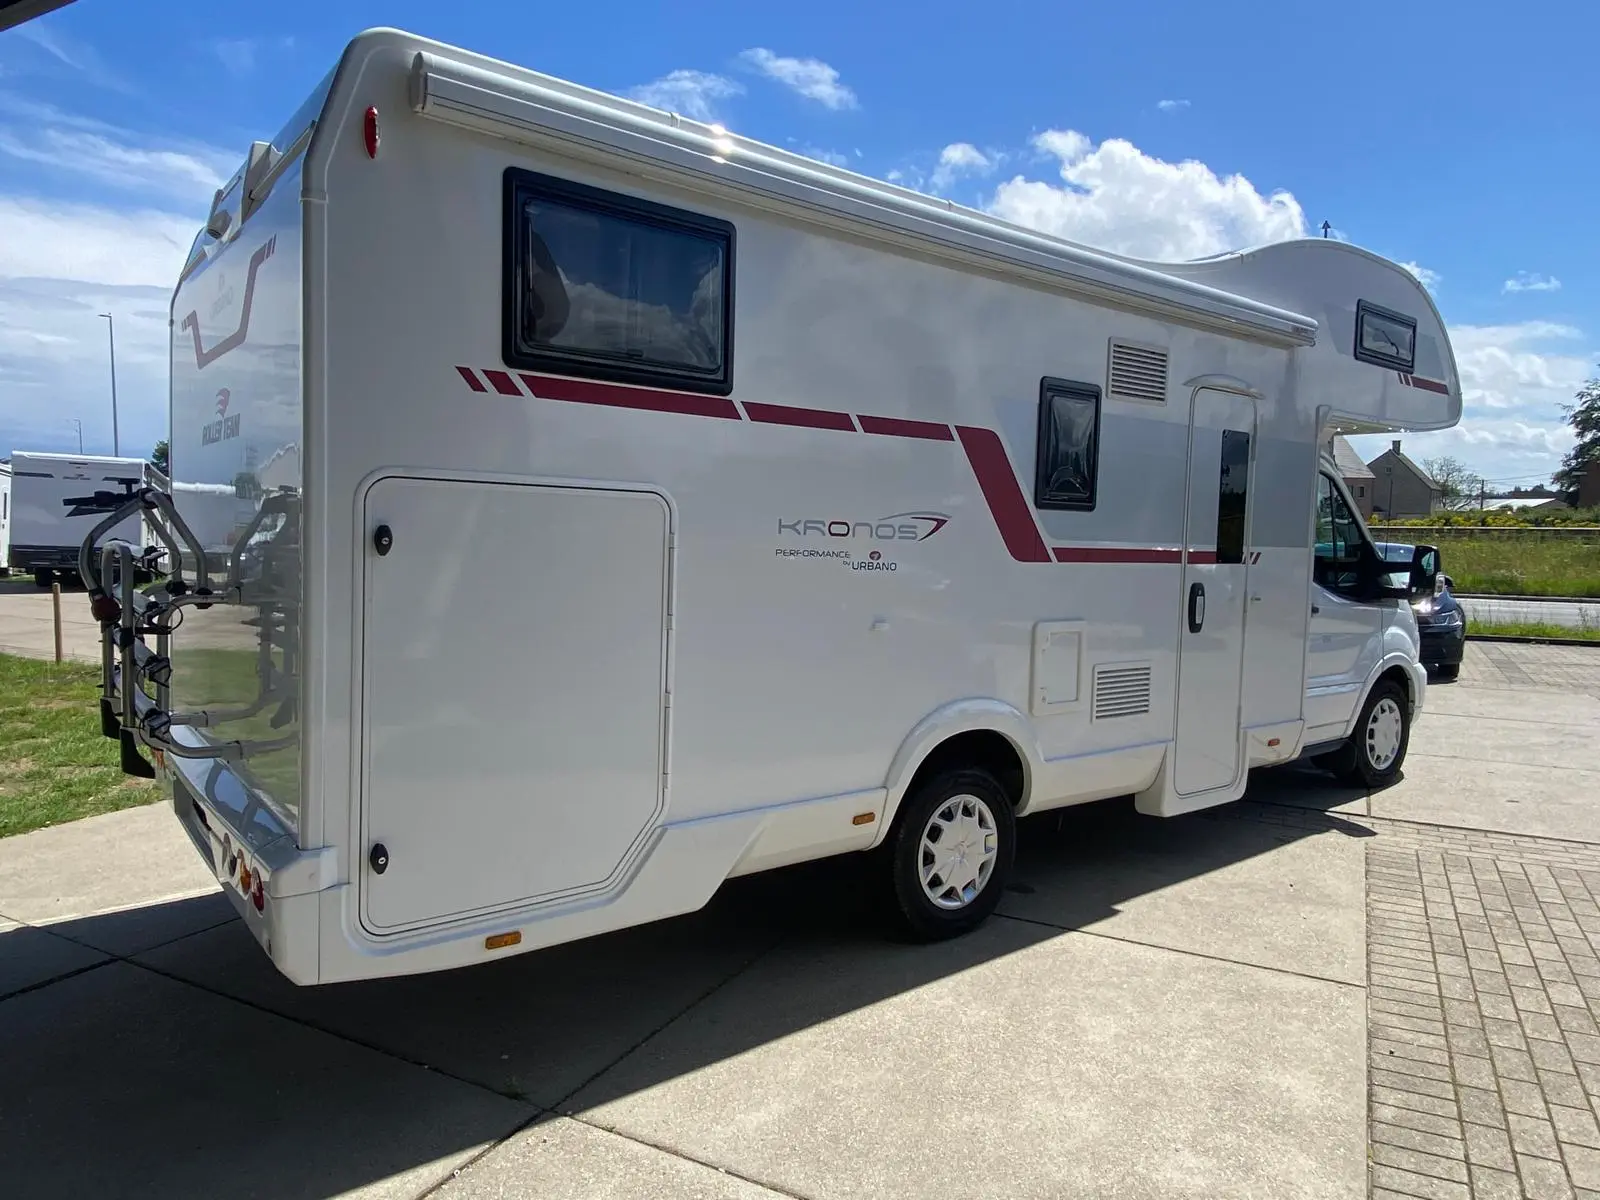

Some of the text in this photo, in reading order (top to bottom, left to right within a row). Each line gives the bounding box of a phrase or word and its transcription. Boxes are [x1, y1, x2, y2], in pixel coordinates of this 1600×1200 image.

[223, 413, 240, 440] TEAM
[775, 549, 851, 559] PERFORMANCE
[851, 561, 898, 571] URBANO
